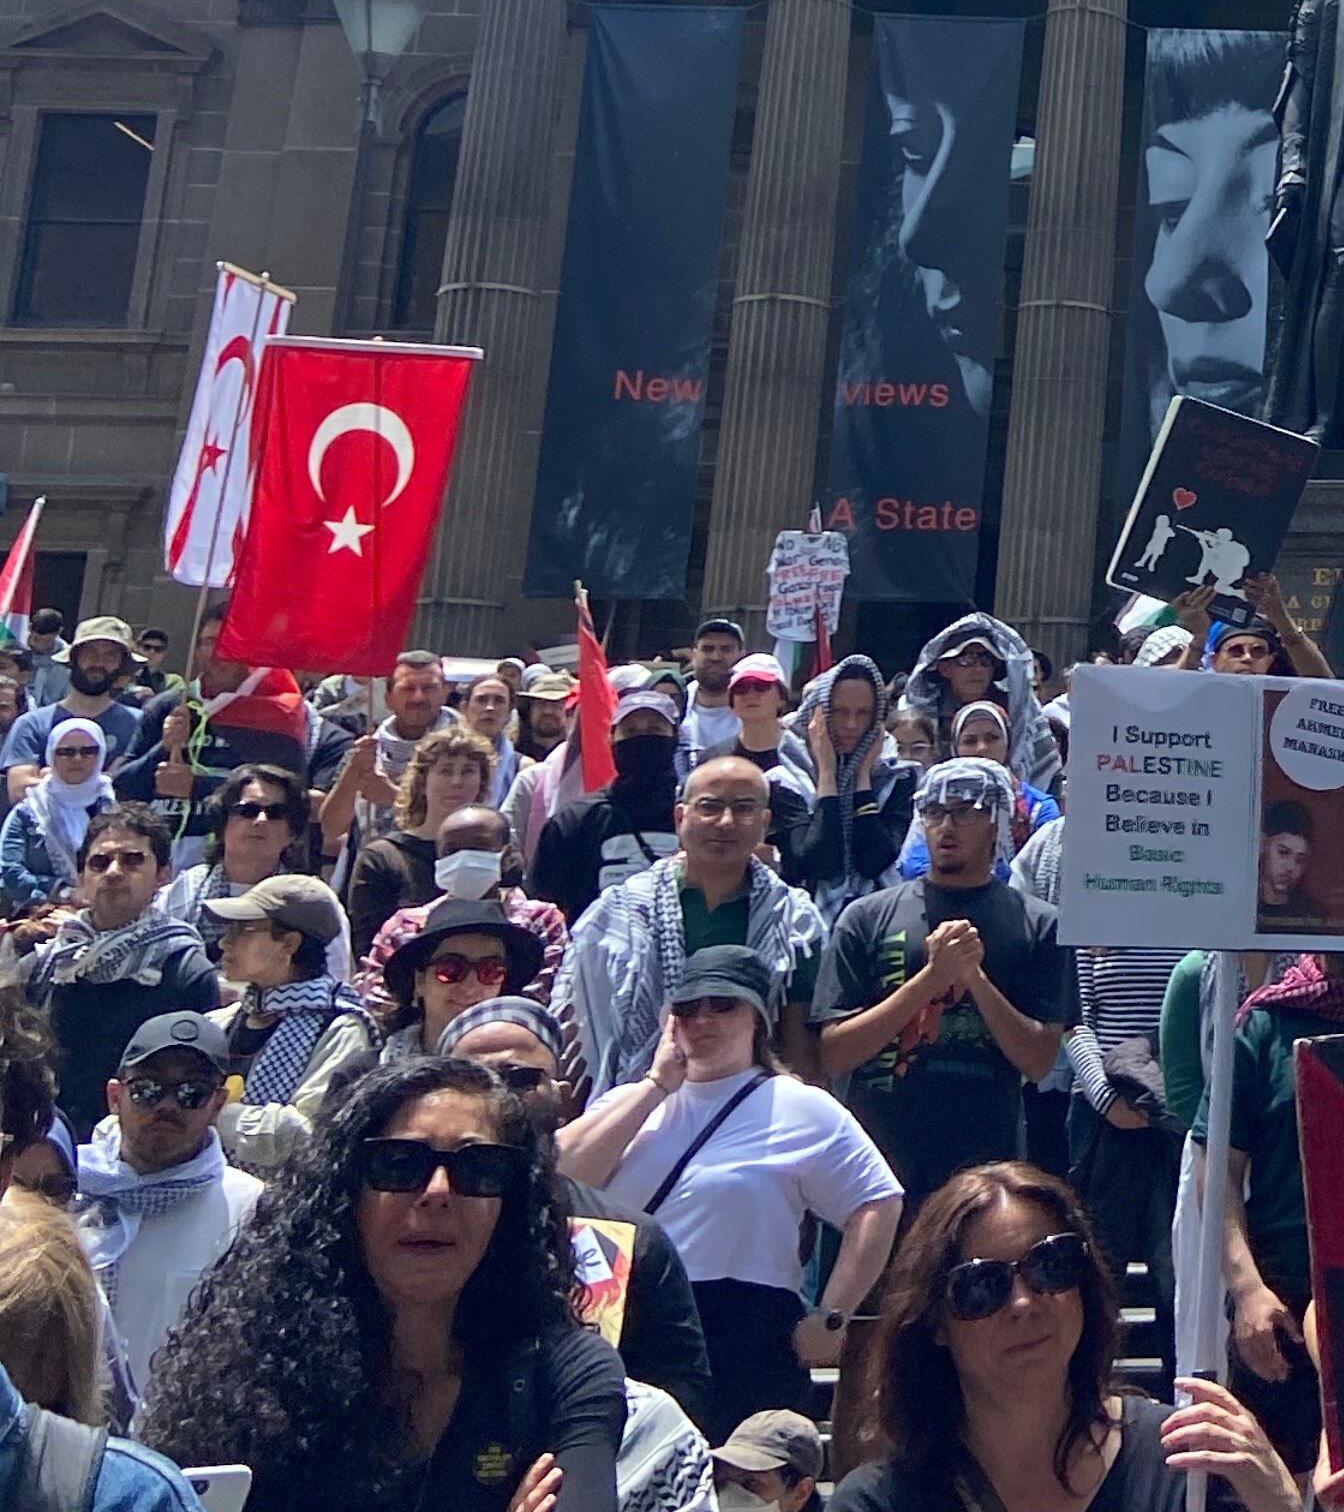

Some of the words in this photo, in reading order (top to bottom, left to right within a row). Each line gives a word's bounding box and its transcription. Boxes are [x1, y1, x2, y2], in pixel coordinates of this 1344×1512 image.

[613, 369, 701, 402] New
[841, 379, 949, 408] views
[828, 497, 854, 531] A
[875, 499, 978, 531] State
[1111, 725, 1119, 743] I
[1124, 724, 1214, 749] Support
[1095, 753, 1225, 779] PALESTINE
[1105, 784, 1201, 806] Because
[1205, 787, 1213, 807] I
[1105, 813, 1186, 835] Believe
[1191, 818, 1211, 837] in
[1083, 872, 1158, 893] Human
[1160, 874, 1226, 898] Rights
